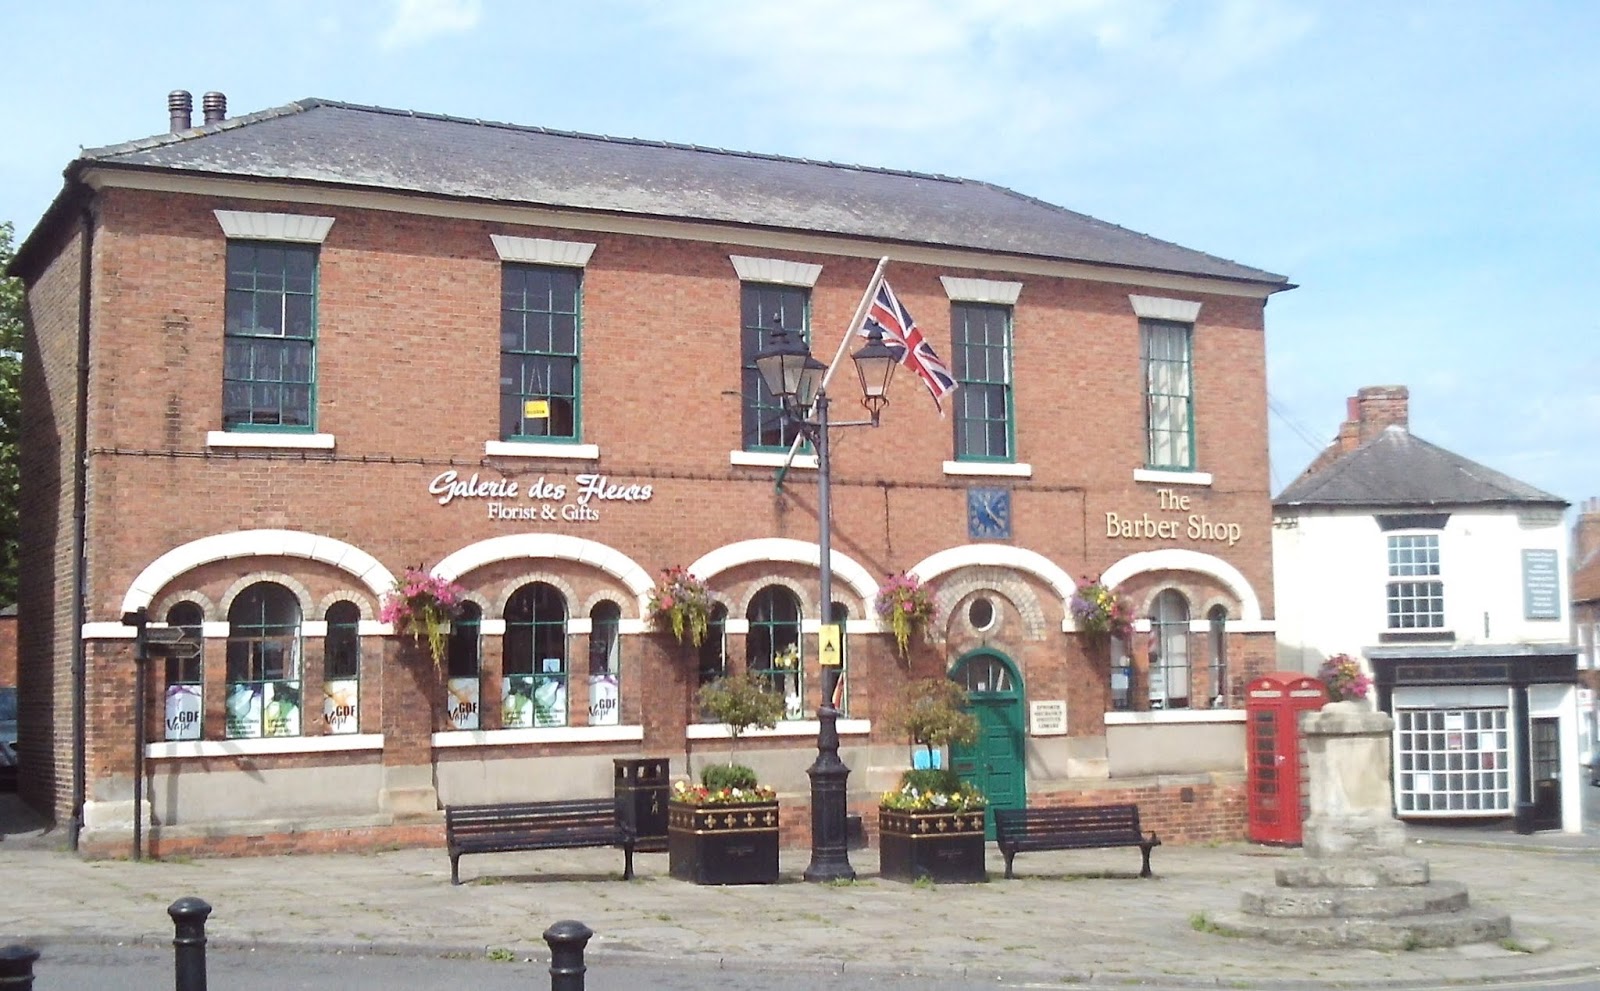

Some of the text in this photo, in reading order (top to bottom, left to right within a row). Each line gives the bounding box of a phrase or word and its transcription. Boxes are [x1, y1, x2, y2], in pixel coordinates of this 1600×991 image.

[428, 470, 653, 506] Galerie des Fleurs
[1157, 489, 1191, 511] The
[487, 503, 600, 521] Florist & Gifts
[1105, 512, 1241, 546] Barber Shop
[336, 705, 356, 717] GDF
[459, 702, 477, 713] GDF
[599, 698, 617, 709] GDF
[166, 716, 191, 736] Vape
[179, 711, 200, 723] GDF
